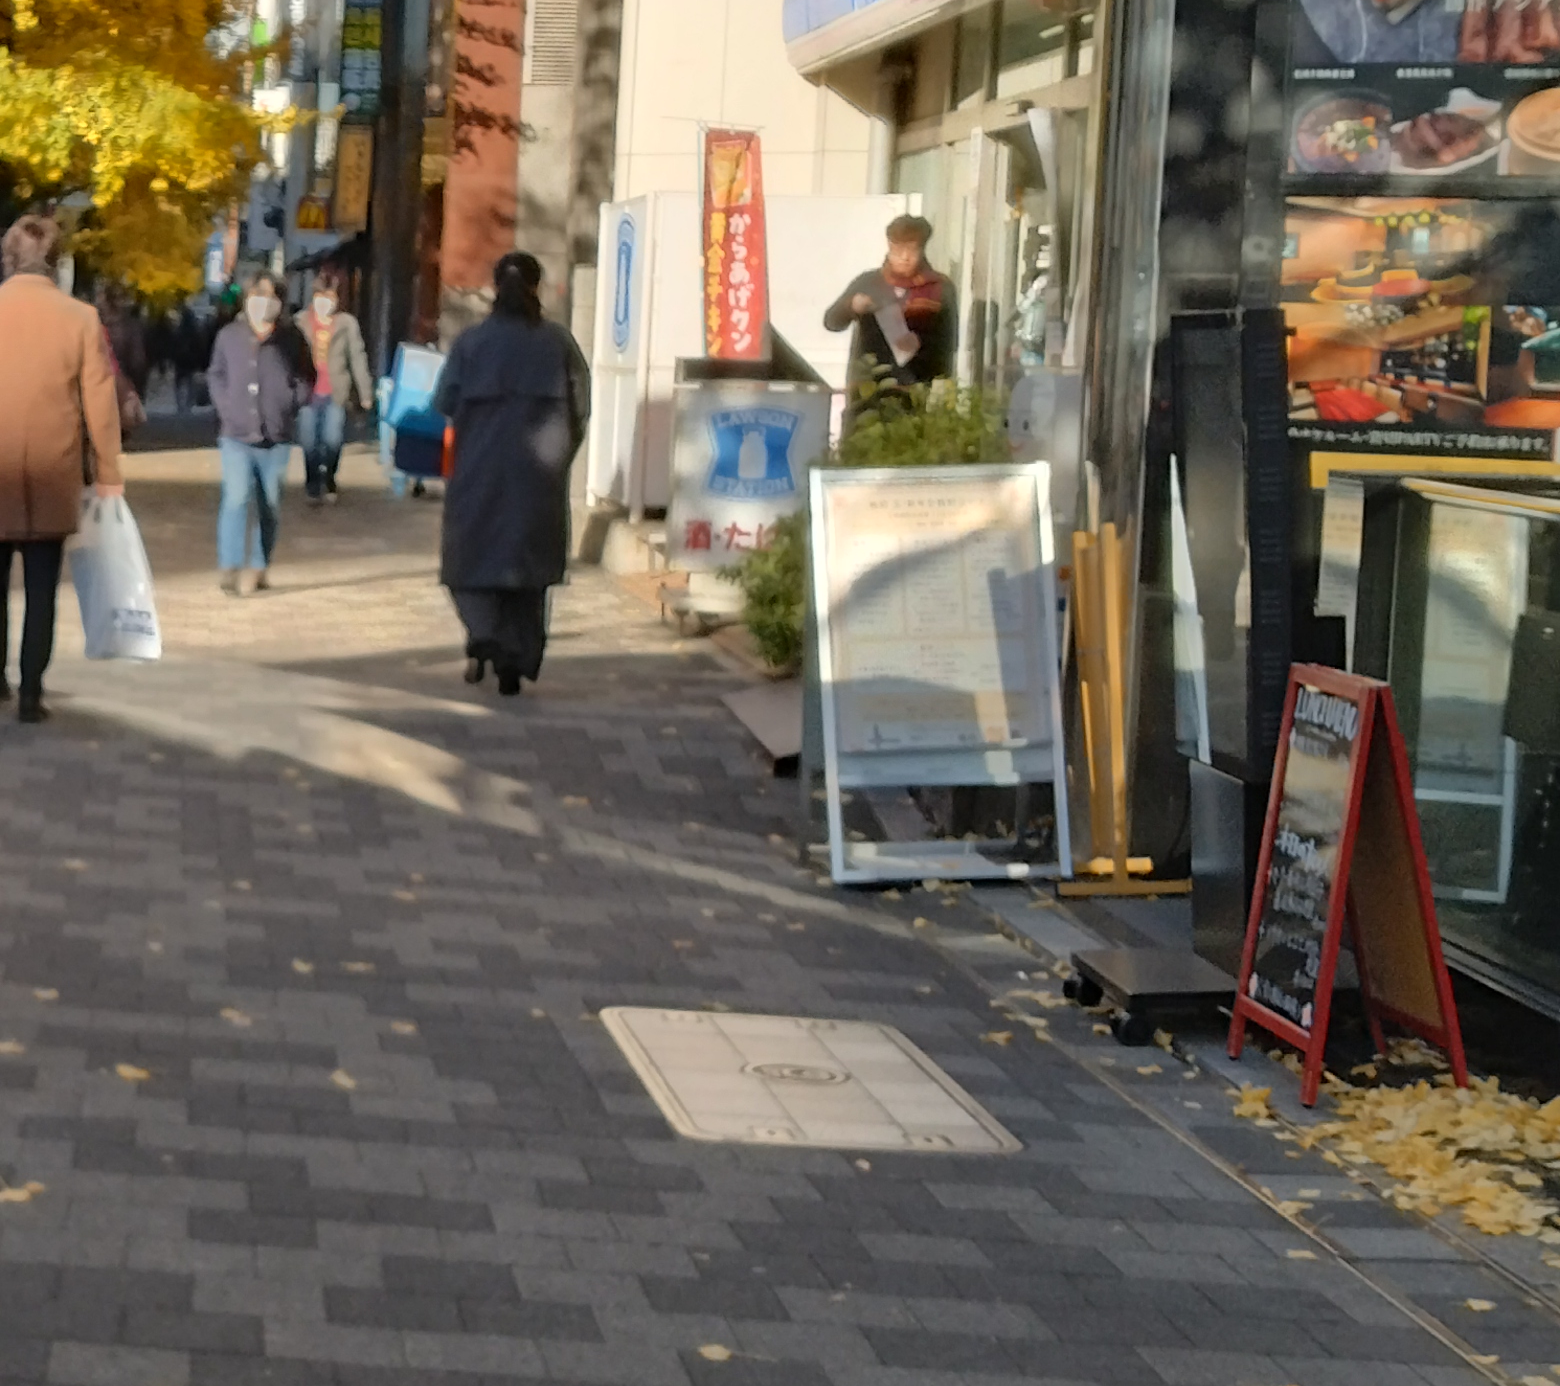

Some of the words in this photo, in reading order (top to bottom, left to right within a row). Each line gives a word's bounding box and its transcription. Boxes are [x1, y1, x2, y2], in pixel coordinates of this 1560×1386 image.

[727, 213, 756, 354] からあげクン
[711, 474, 792, 497] STATION
